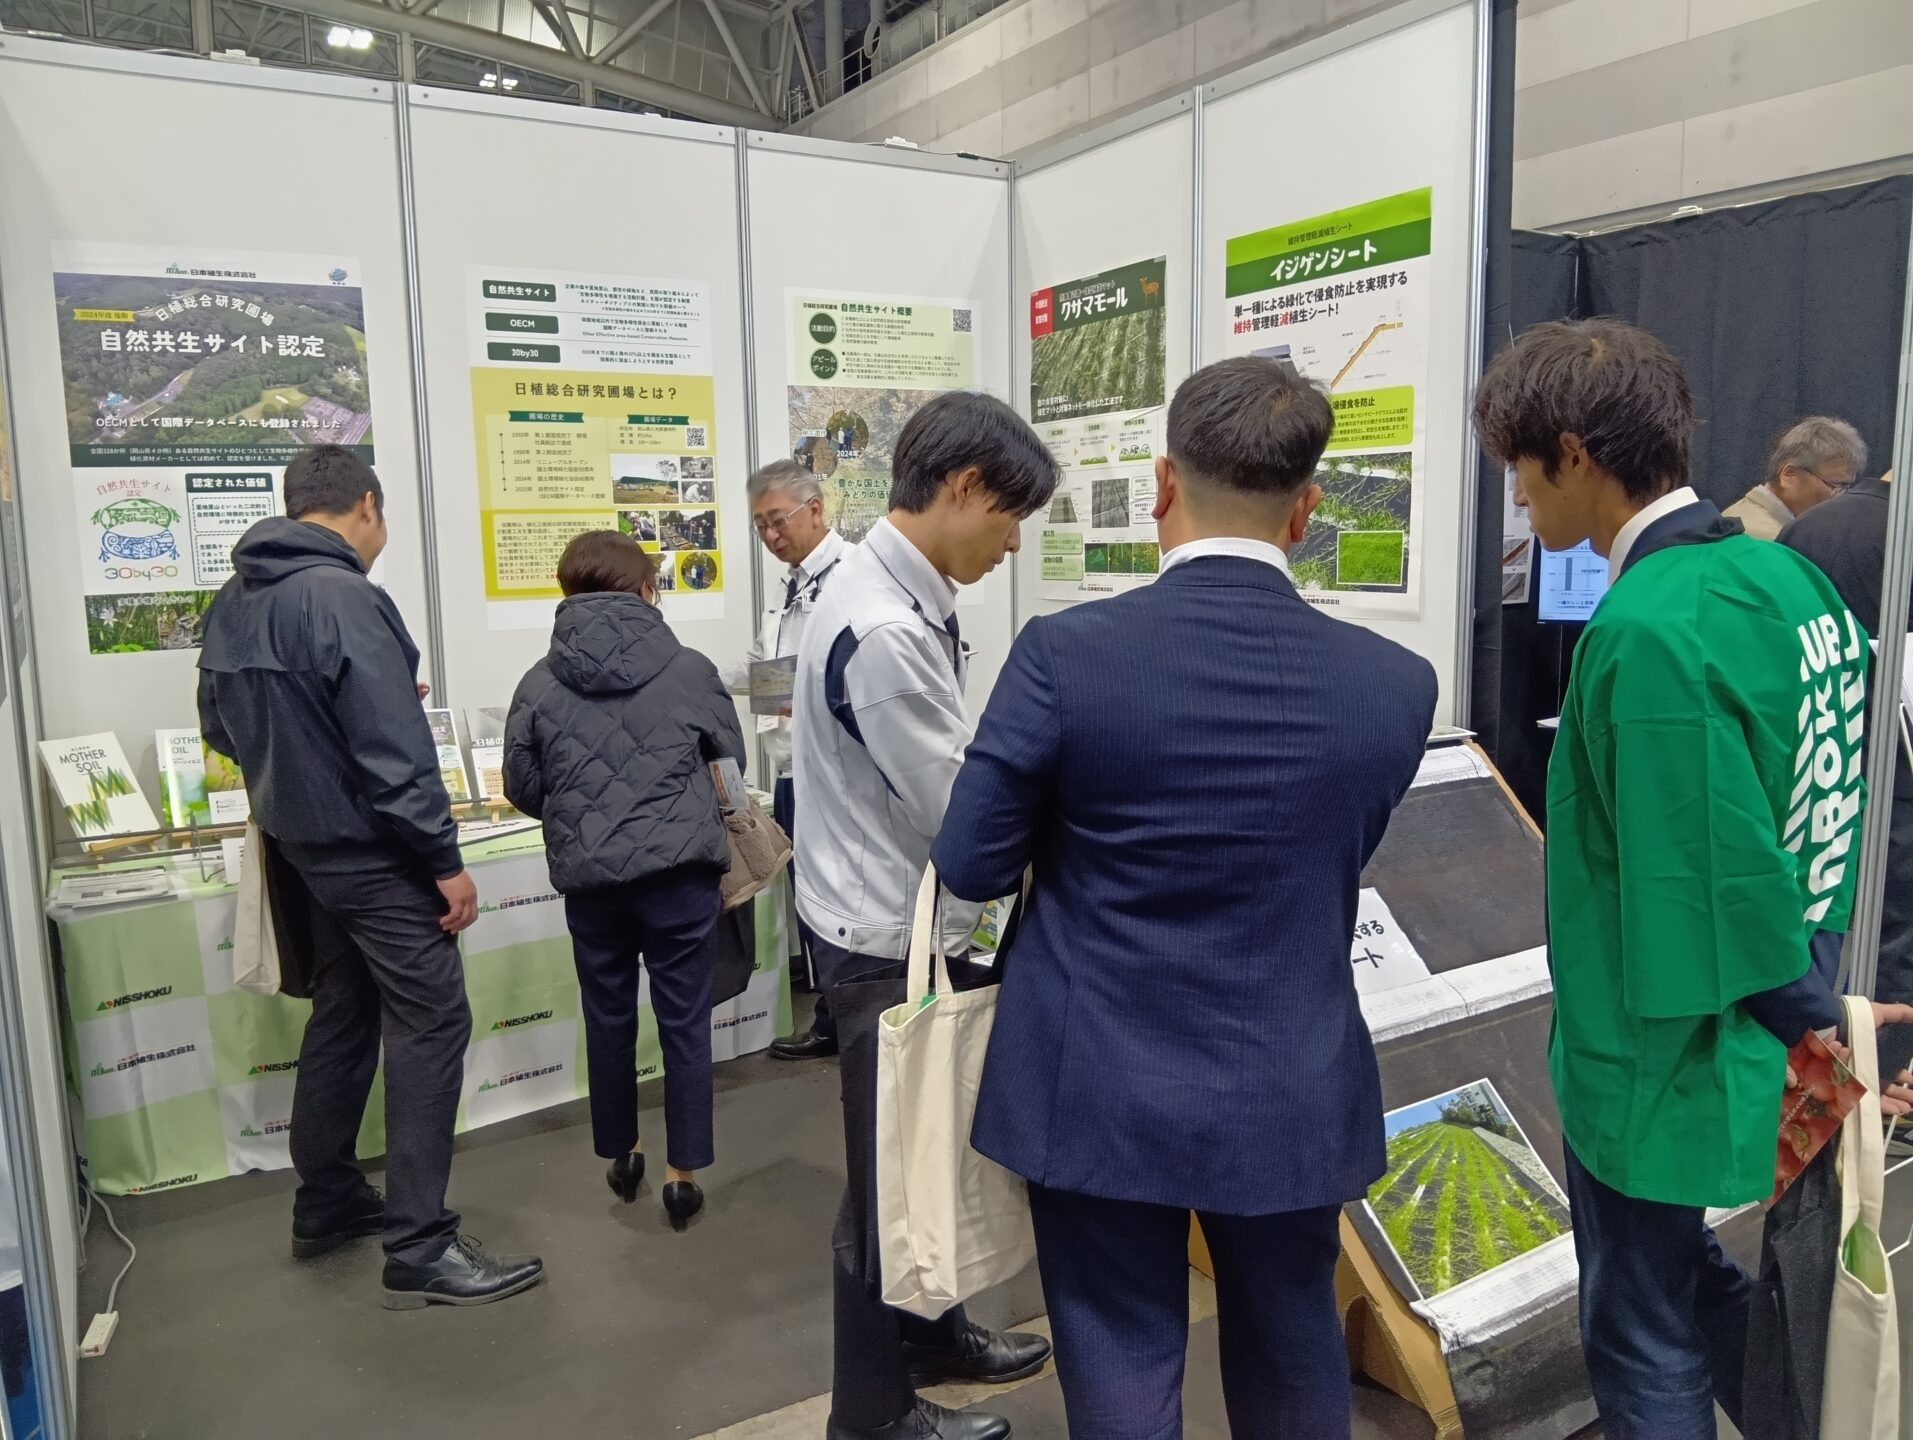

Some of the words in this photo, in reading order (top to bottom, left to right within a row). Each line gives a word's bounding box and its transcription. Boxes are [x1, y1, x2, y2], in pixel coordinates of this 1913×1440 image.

[1270, 238, 1377, 281] イジゲンシート
[488, 284, 550, 298] 自然共生サイト
[1234, 271, 1408, 318] 単一種による緑化で侵食防止を実現する
[154, 293, 275, 327] 日植総合研究圃場
[841, 302, 913, 316] 自然共生サイト概要
[1061, 286, 1128, 321] クサマモール
[509, 318, 536, 329] OECM
[100, 328, 326, 358] 自然共生サイト認定
[511, 348, 539, 359] 30by30
[811, 355, 837, 363] アピール
[812, 364, 837, 373] ポイント
[96, 417, 342, 430] OECMとして国際データベースにも登録されました
[528, 413, 565, 421] 圃場の歴史
[836, 450, 859, 458] 2024年
[96, 478, 172, 496] 自然共生サイト
[192, 477, 267, 489] 認定された価値
[105, 565, 178, 581] 30by30
[59, 749, 107, 765] MOTHER
[76, 760, 102, 773] SOIL
[112, 985, 173, 1008] NISSHOKU
[504, 1009, 553, 1028] NISSHOKU
[117, 1043, 197, 1071] 日本植生株式会社
[500, 1063, 563, 1086] 日本植生株式会社
[139, 1173, 198, 1193] NISSHOKU
